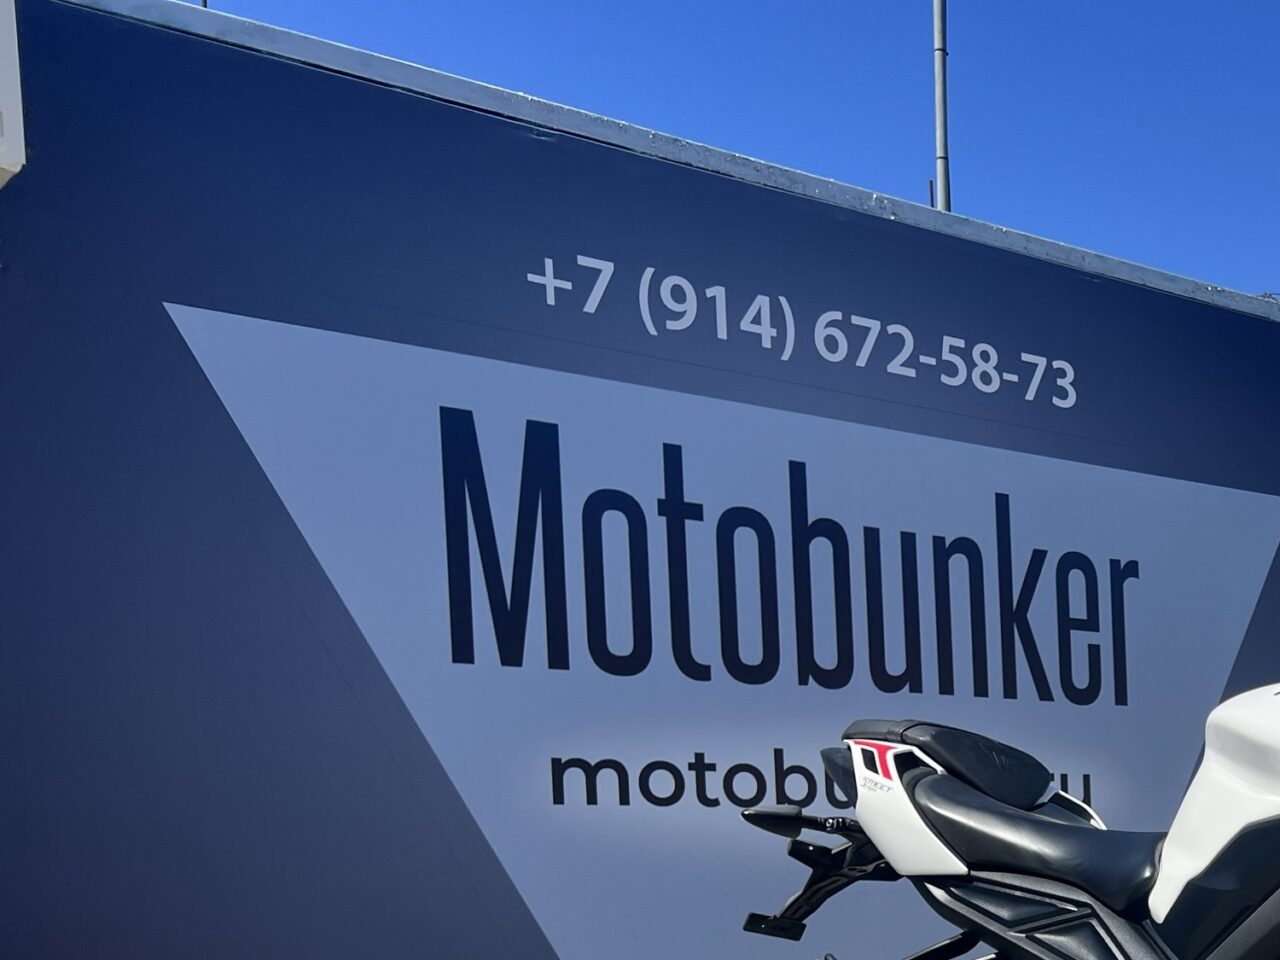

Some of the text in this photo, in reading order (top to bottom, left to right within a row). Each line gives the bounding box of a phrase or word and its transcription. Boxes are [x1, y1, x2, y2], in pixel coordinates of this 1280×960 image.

[527, 254, 1078, 409] +7 (914) 672-58-73
[438, 405, 1140, 707] Motobunker
